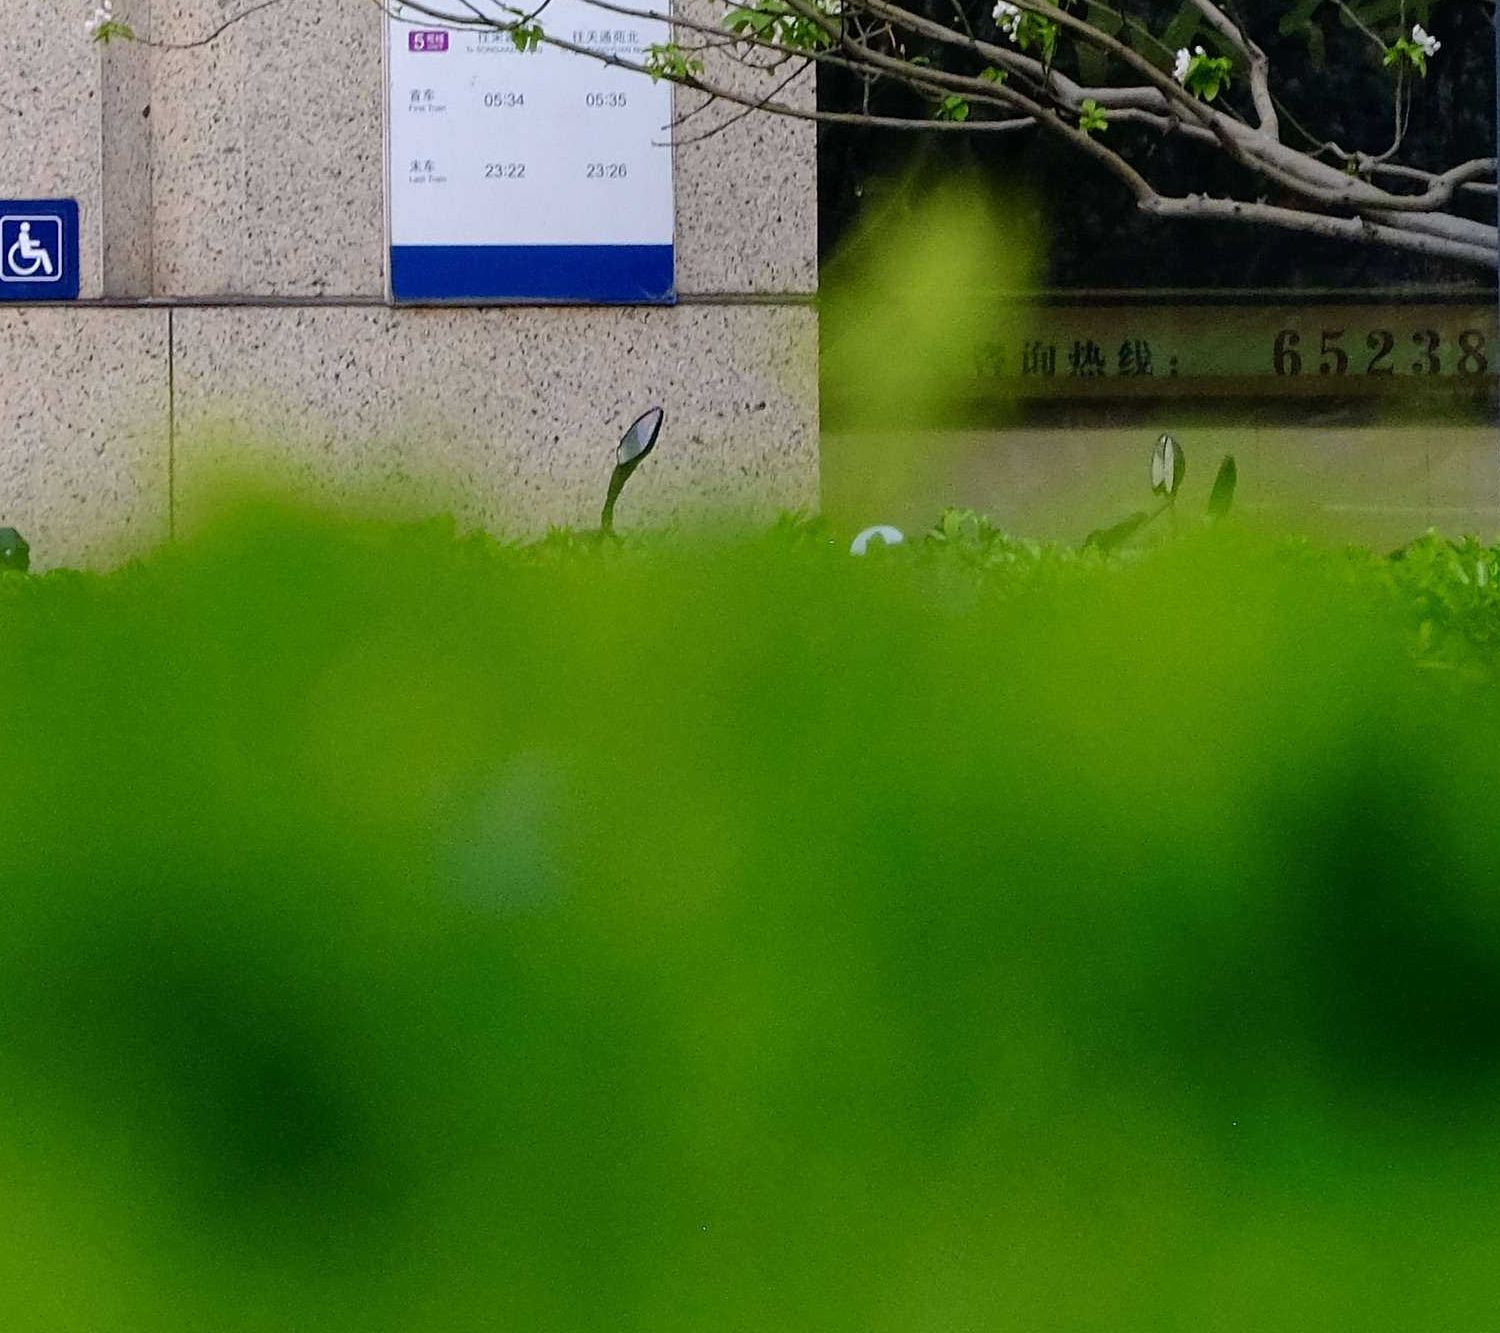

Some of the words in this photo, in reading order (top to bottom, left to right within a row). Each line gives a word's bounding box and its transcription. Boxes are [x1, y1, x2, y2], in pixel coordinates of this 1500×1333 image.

[484, 92, 525, 108] 05:34
[586, 92, 627, 108] 05:35
[485, 163, 526, 179] 23:22
[586, 163, 628, 179] 23:26
